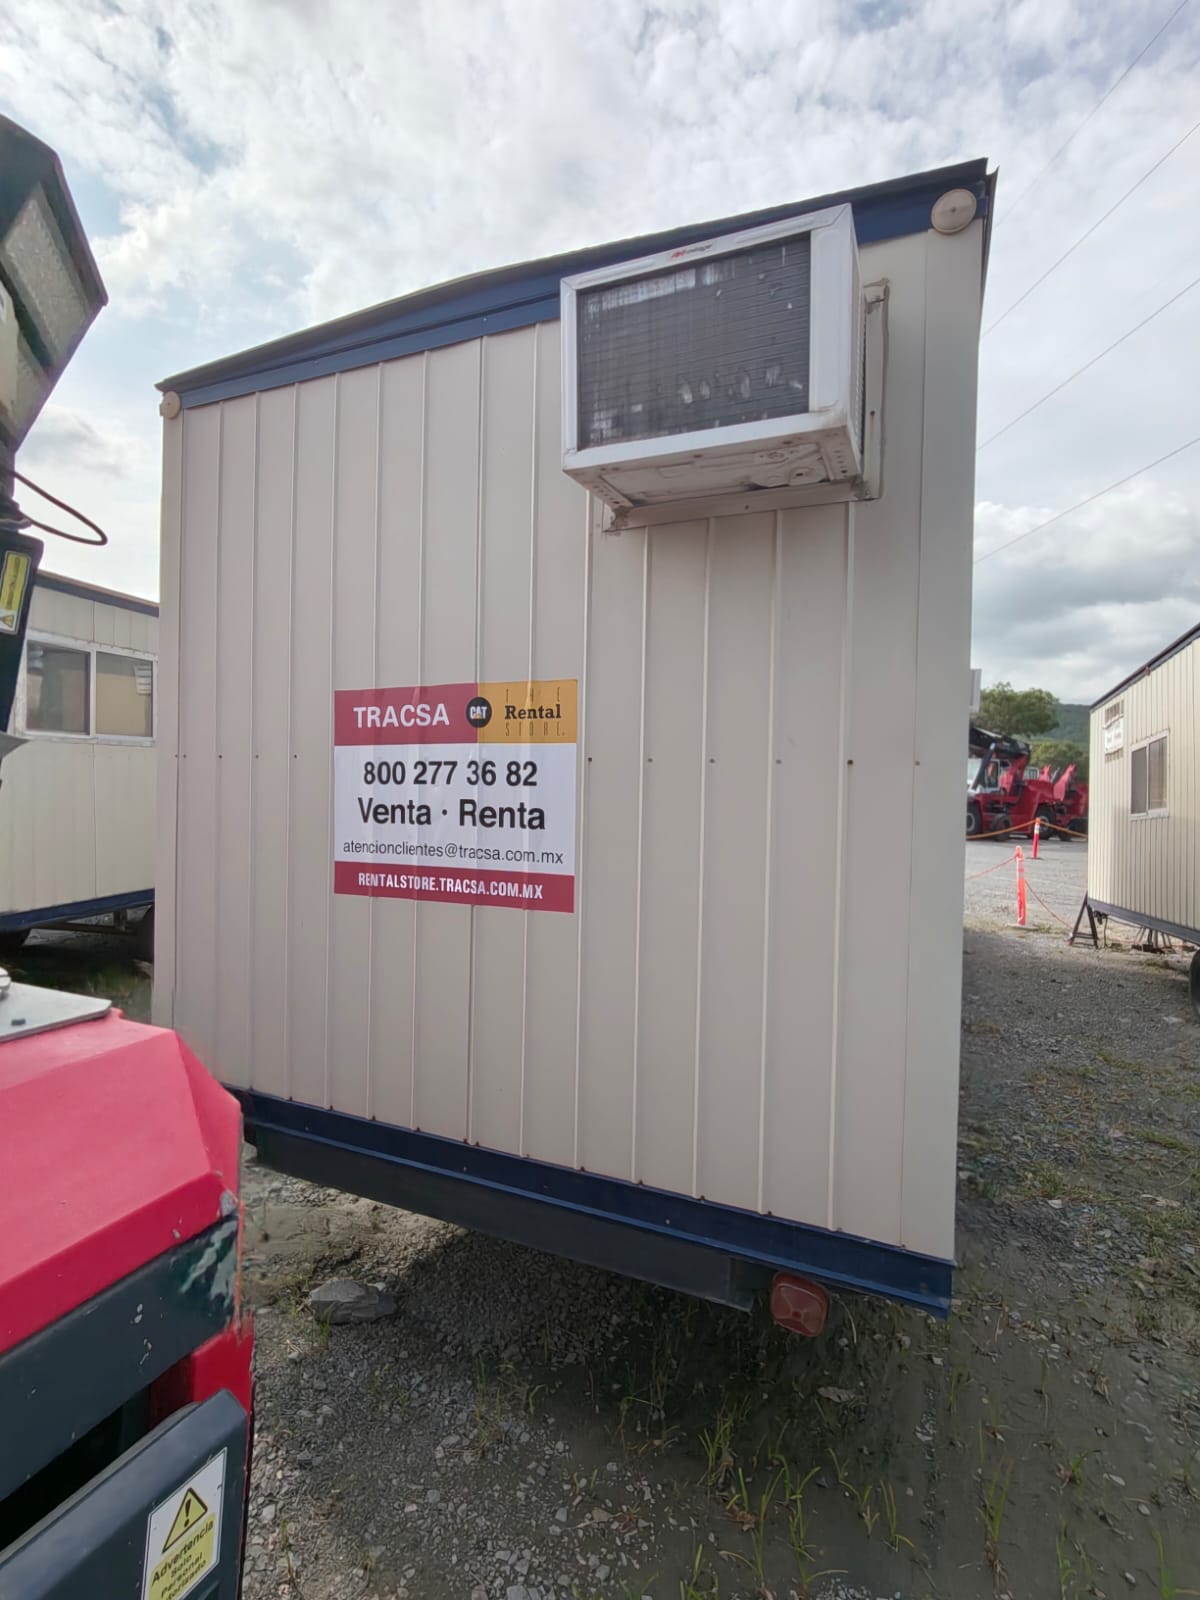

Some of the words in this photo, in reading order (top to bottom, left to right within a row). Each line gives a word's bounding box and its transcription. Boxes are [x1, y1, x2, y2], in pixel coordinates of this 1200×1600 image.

[353, 703, 450, 729] TRACSA
[469, 706, 488, 720] CAT
[504, 704, 562, 720] Rental
[364, 761, 406, 785] 800
[413, 761, 458, 785] 277
[466, 760, 497, 786] 36
[505, 760, 538, 787] 82
[357, 797, 432, 826] Venta
[459, 798, 546, 830] Renta
[343, 840, 563, 864] atencionclientes@tracsa.com.mx
[358, 872, 543, 899] RENTALSTORE.TRACSA.COM.MX
[151, 1520, 214, 1587] Advertencia
[165, 1559, 207, 1600] torizado
